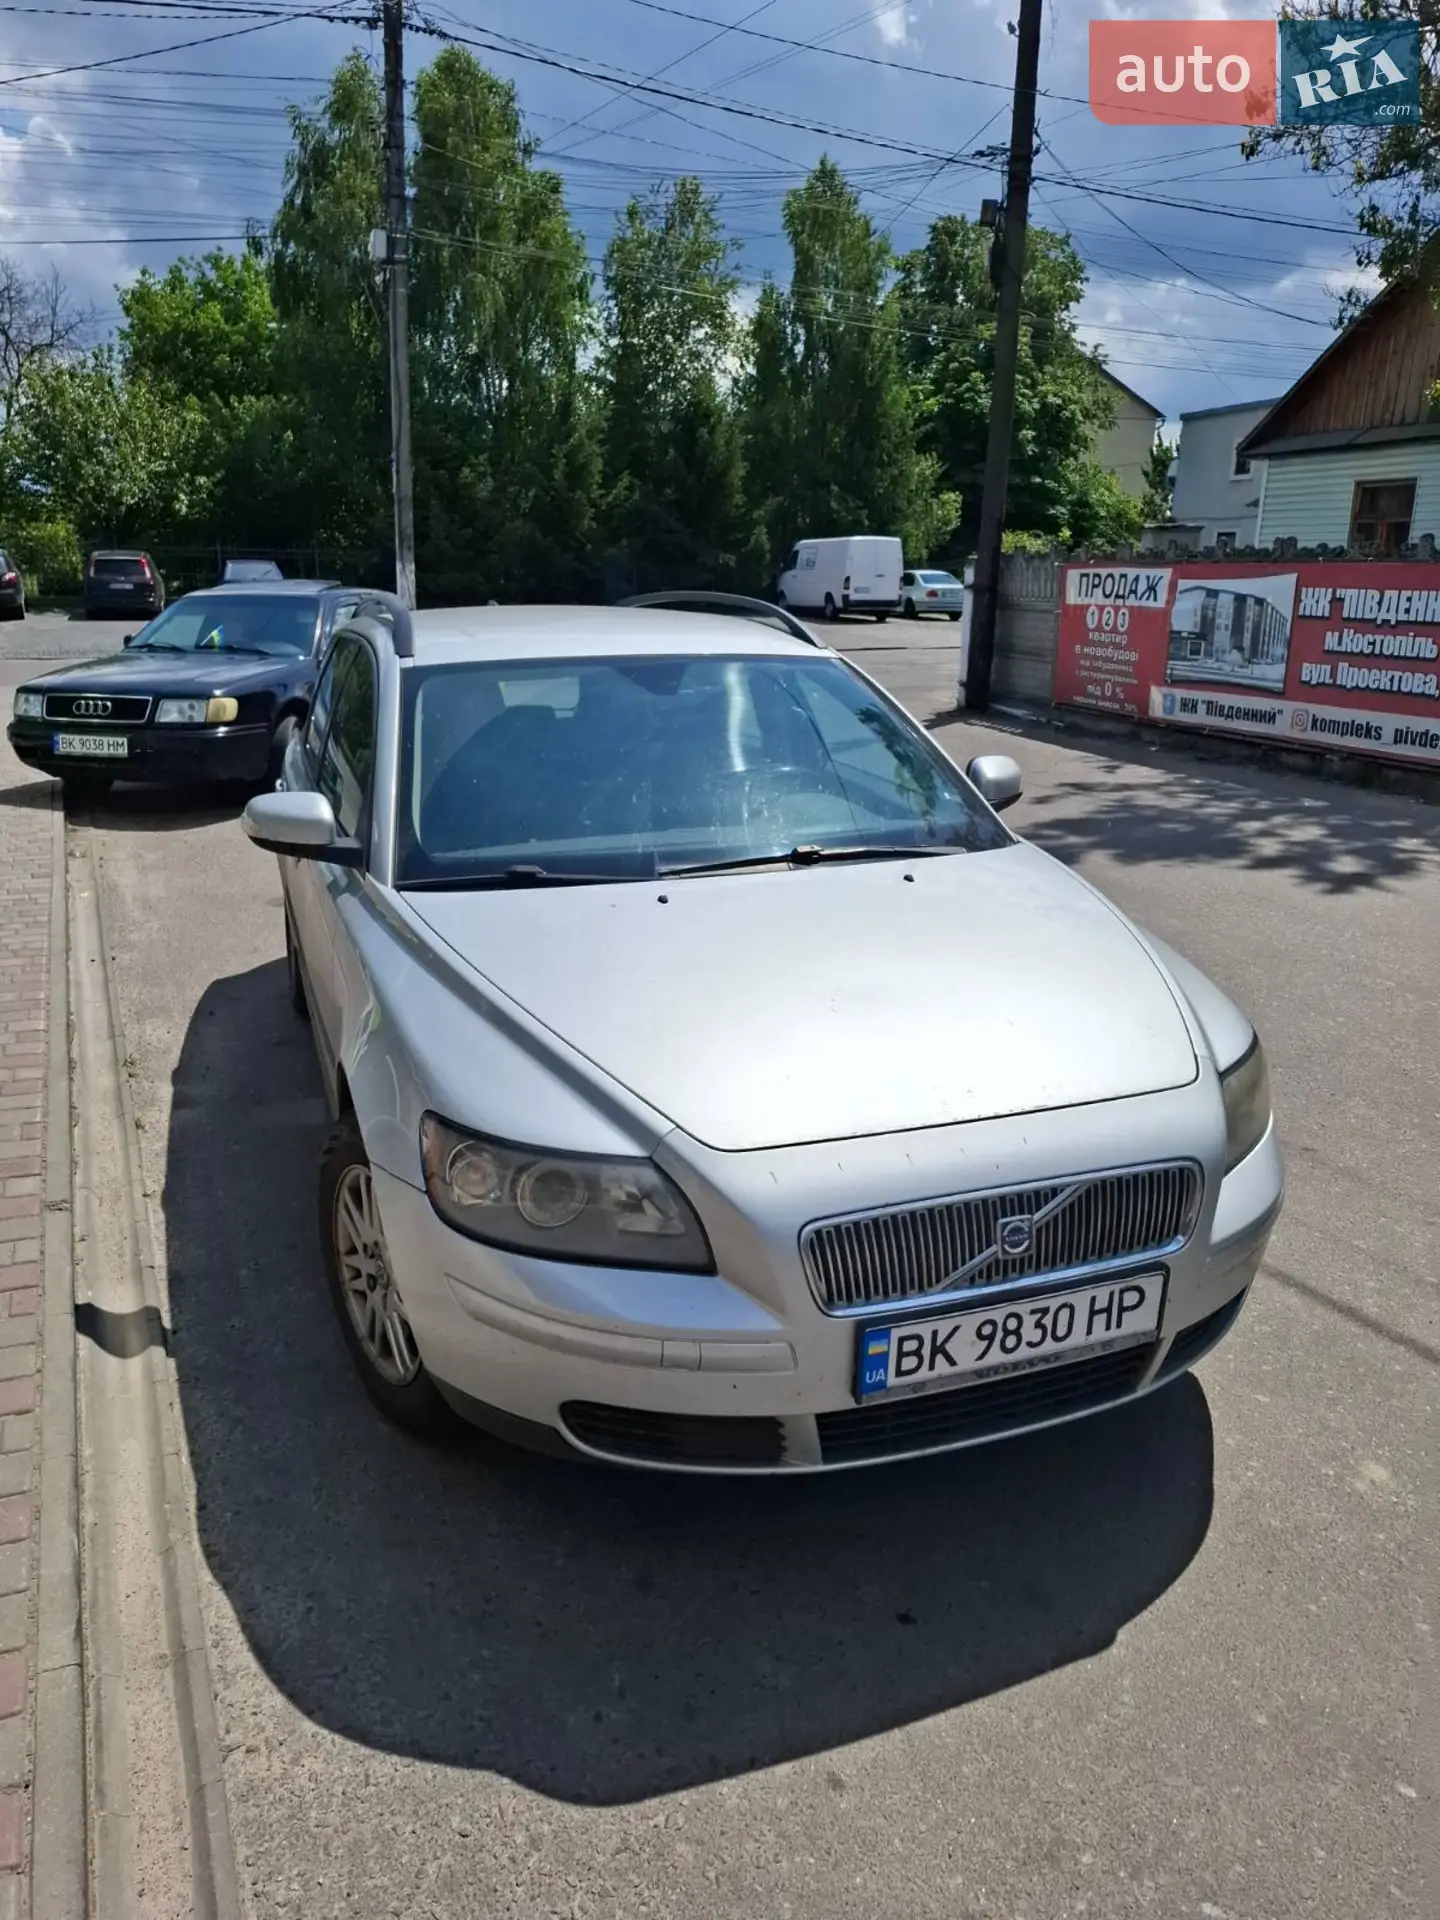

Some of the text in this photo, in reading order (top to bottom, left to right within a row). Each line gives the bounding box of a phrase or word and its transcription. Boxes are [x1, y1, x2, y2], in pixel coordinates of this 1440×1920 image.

[1078, 573, 1164, 605] ПРОДАЖ
[1299, 587, 1333, 617] ЖК
[1088, 631, 1128, 646] квартир
[1301, 662, 1334, 685] вул.
[1180, 697, 1199, 715] ЖК
[61, 737, 76, 750] BK
[79, 738, 104, 751] 9038
[107, 740, 125, 752] HM
[894, 1325, 961, 1378] BK
[975, 1302, 1075, 1361] 9830
[1086, 1284, 1145, 1336] HP
[866, 1369, 885, 1384] UA
